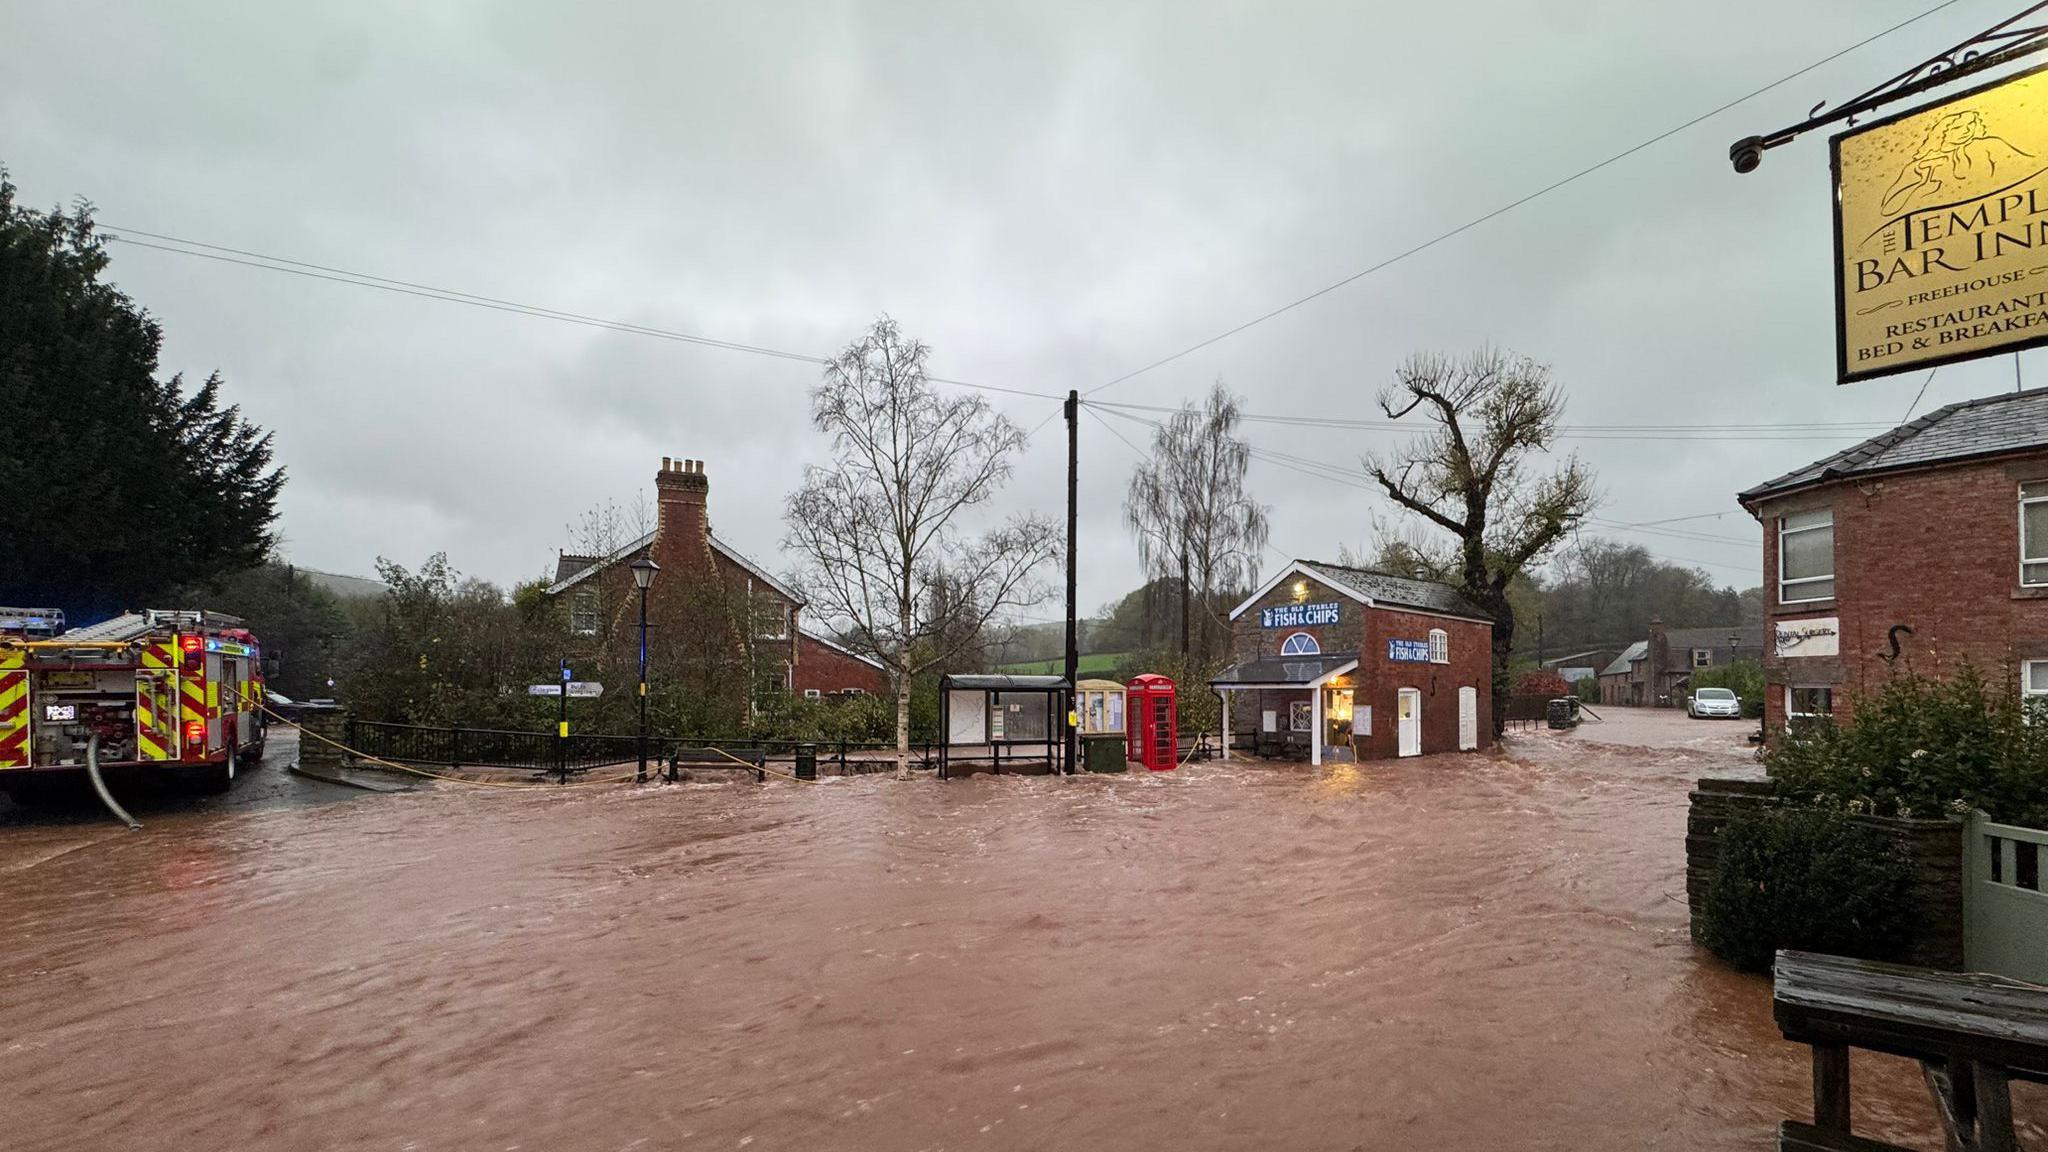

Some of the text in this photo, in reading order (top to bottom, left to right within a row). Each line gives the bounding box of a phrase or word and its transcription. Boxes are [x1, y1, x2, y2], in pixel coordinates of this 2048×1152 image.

[1883, 229, 1896, 256] THE
[1856, 220, 2048, 293] BAR IN
[1908, 269, 2025, 306] FREEHOUSE
[1858, 341, 1904, 361] BED
[1911, 337, 1931, 350] &
[1291, 605, 1304, 613] OLD
[1307, 602, 1338, 611] STABLES
